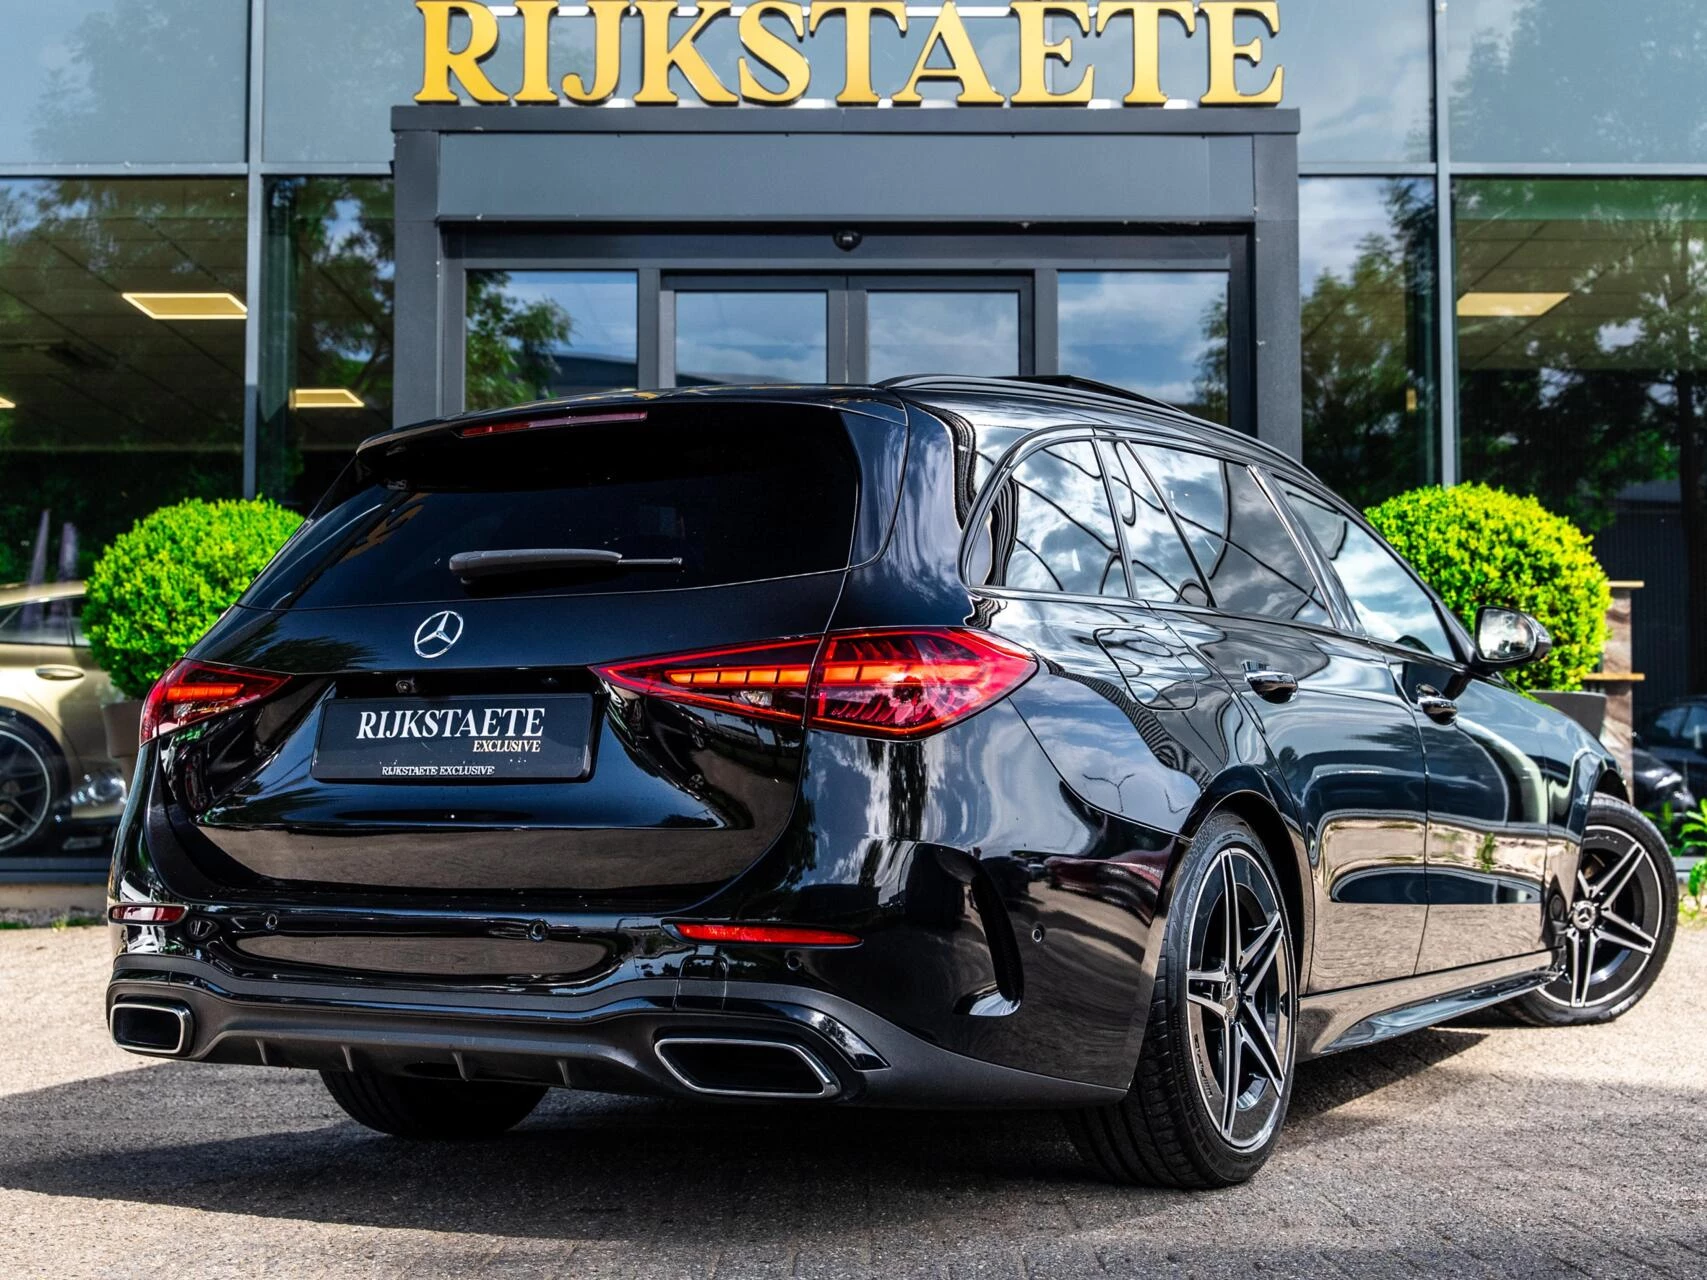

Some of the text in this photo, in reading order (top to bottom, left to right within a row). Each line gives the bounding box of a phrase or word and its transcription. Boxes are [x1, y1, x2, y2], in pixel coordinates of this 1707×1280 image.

[413, 0, 1285, 107] RIJKSTAETE
[356, 707, 546, 740] RIJKSTAETE
[472, 740, 542, 753] EXCLUSIVE
[382, 766, 495, 776] RIJKSTAETE EXCLUSIVE
